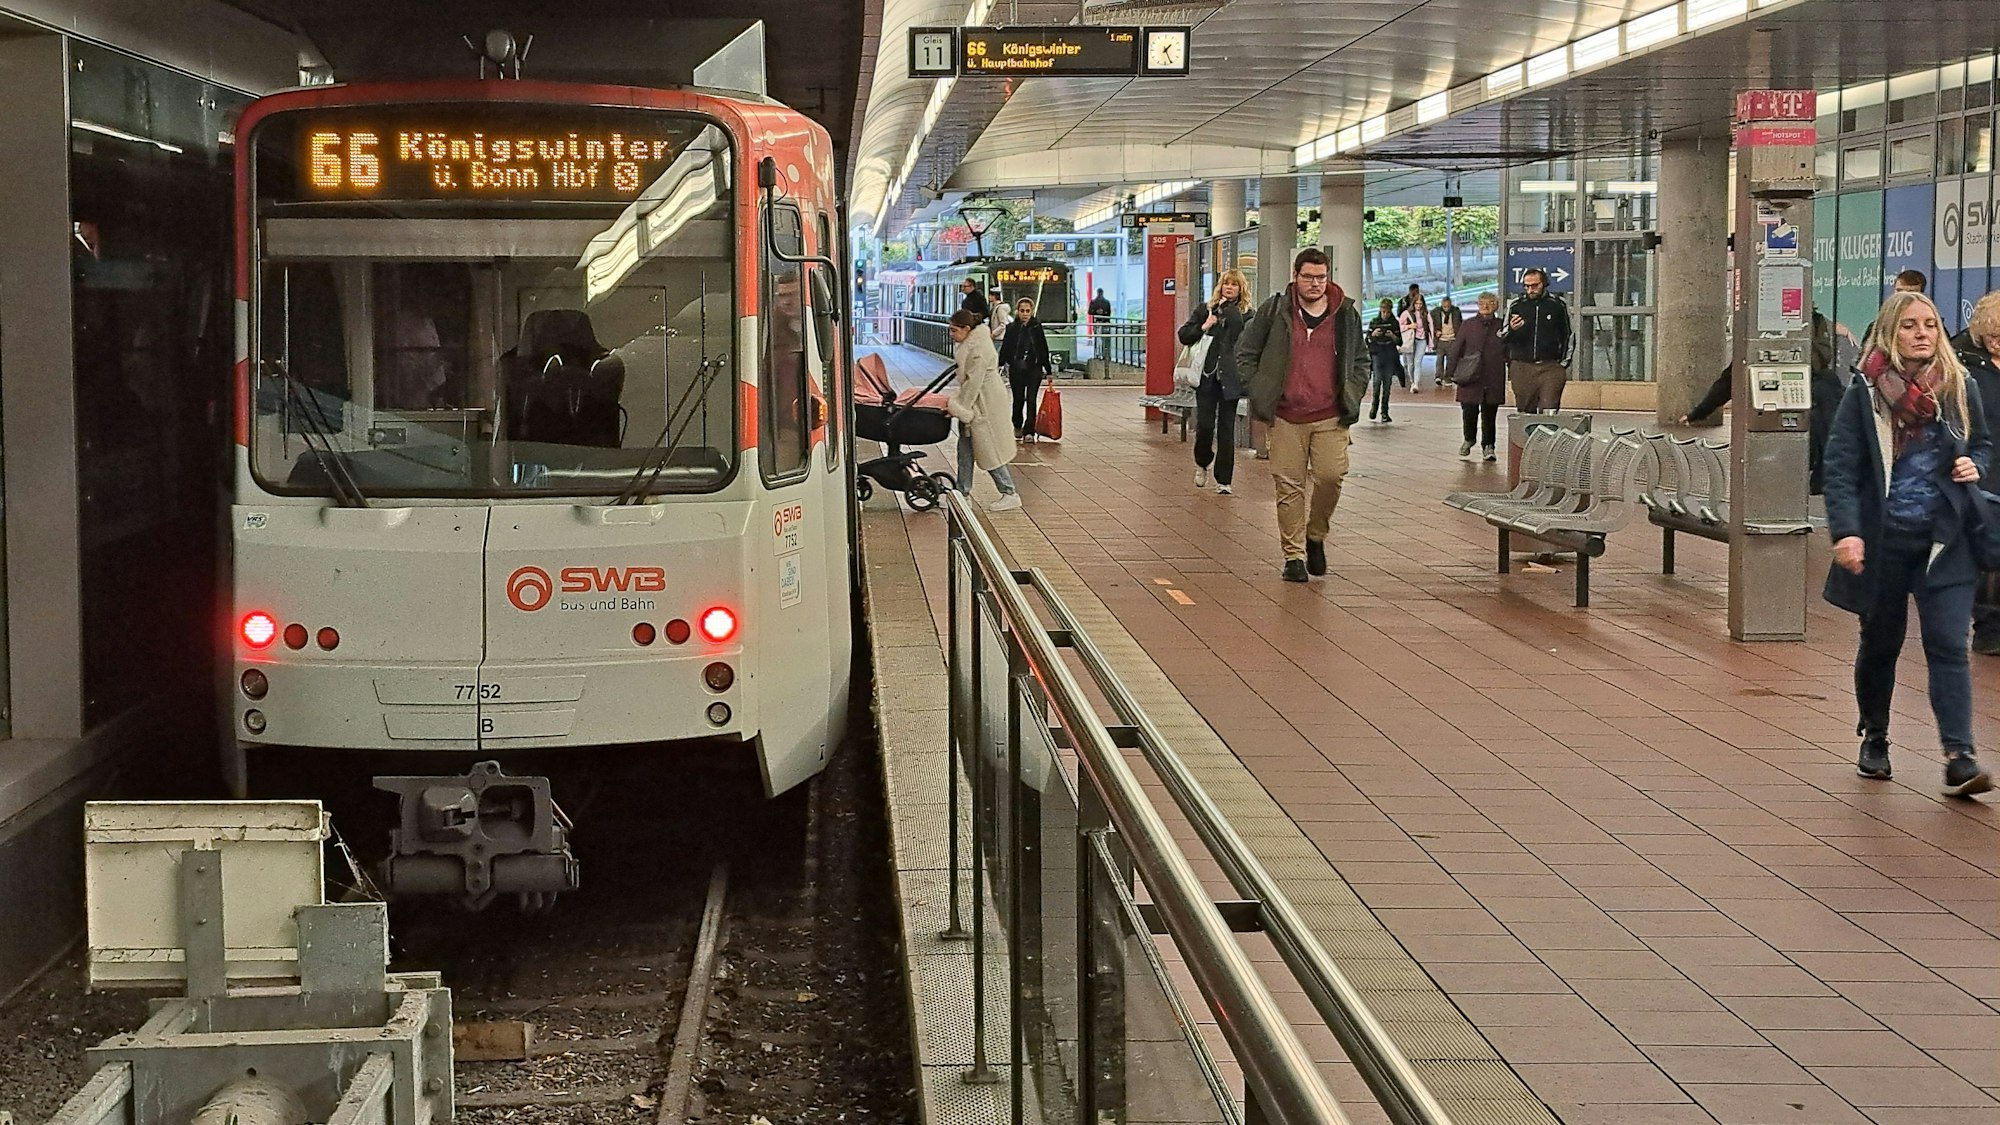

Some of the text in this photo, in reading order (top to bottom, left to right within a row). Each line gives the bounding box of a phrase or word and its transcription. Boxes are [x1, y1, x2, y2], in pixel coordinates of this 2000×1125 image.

[923, 36, 943, 45] Gleis
[967, 41, 1081, 56] 66 Königswinter
[924, 47, 943, 66] 11
[982, 58, 1056, 68] Hauptbahnhof
[311, 132, 669, 188] 66 Königswinter
[433, 164, 458, 188] ü.
[471, 162, 538, 188] Bonn
[553, 162, 599, 188] Hbf
[1968, 199, 2000, 226] SW
[1509, 248, 1515, 256] 6
[1841, 232, 1882, 260] KLUGER
[1887, 230, 1913, 257] ZUG
[997, 271, 1009, 281] 66
[783, 506, 802, 523] SWB
[785, 533, 797, 548] 7752
[561, 567, 666, 592] SWB
[590, 598, 616, 611] und
[621, 597, 655, 611] Bahn
[481, 718, 495, 733] B
